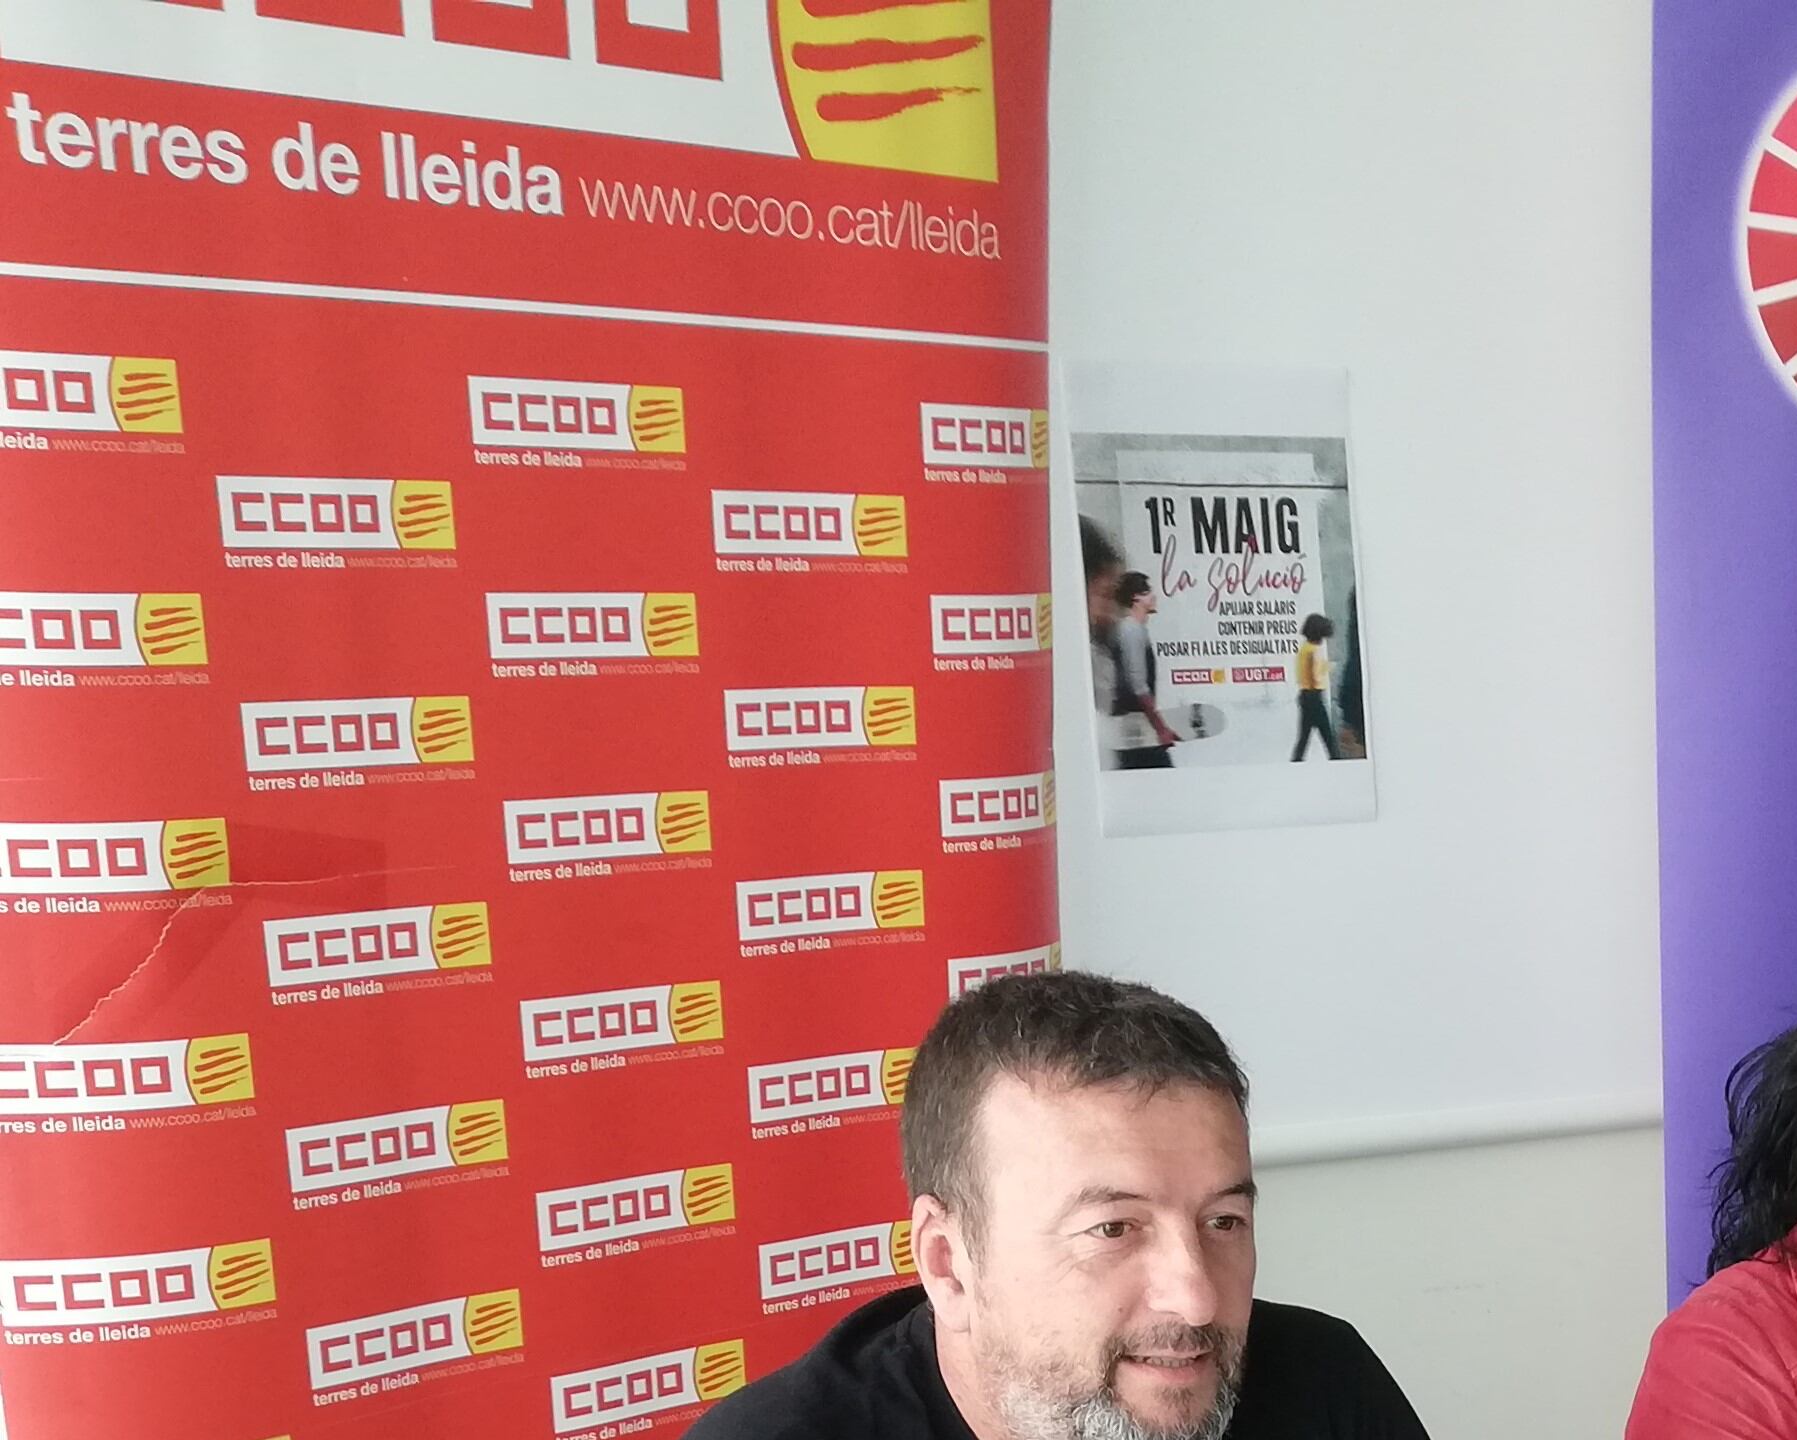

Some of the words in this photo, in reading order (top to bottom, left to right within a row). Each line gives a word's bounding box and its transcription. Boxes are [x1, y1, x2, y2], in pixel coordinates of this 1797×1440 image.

[5, 91, 249, 185] terres
[271, 121, 361, 196] de
[380, 131, 565, 217] lleida
[578, 176, 1001, 260] www.ccoo.cat/lleida
[483, 393, 617, 435] CCOO
[932, 418, 1024, 454] CCOO
[474, 449, 518, 466] terres
[521, 450, 541, 466] de
[544, 451, 582, 468] lleida
[232, 493, 381, 533] CCOO
[724, 506, 841, 541] CCOO
[1190, 496, 1301, 554] MAIG
[225, 553, 274, 568] terres
[277, 553, 298, 568] de
[301, 552, 345, 568] lleida
[1162, 534, 1197, 597] la
[499, 608, 629, 644] CCOO
[942, 608, 1032, 641] CCOO
[1219, 601, 1254, 616] APUJAR
[1257, 600, 1296, 615] SALARIS
[0, 608, 121, 651] COO
[1218, 621, 1265, 636] CONTENIR
[1267, 620, 1298, 635] PREUS
[1156, 641, 1190, 657] POSAR
[1191, 641, 1199, 656] FI
[1202, 641, 1210, 656] A
[1210, 640, 1228, 656] LES
[1230, 639, 1299, 655] DESIGUALTATS
[256, 714, 400, 756] CCOO
[736, 701, 853, 737] CCOO
[728, 755, 766, 768] terres
[769, 752, 784, 765] de
[787, 750, 820, 764] lleida
[249, 775, 295, 791] terres
[300, 774, 319, 789] de
[323, 770, 365, 786] lleida
[951, 790, 1037, 824] CCOO
[517, 809, 645, 849] CCOO
[0, 839, 147, 879] COO
[509, 868, 552, 882] terres
[556, 863, 572, 877] de
[575, 861, 612, 876] lleida
[748, 887, 861, 927] CCOO
[279, 923, 417, 971] CCOO
[740, 944, 777, 957] terres
[780, 940, 795, 953] de
[798, 936, 831, 951] lleida
[272, 990, 317, 1005] terres
[321, 984, 340, 999] de
[343, 980, 384, 997] lleida
[533, 1001, 657, 1047] CCOO
[526, 1064, 568, 1078] terres
[571, 1059, 588, 1073] de
[591, 1054, 626, 1070] lleida
[759, 1065, 871, 1110] CCOO
[299, 1123, 436, 1176] CCOO
[293, 1193, 338, 1210] terres
[342, 1187, 360, 1202] de
[363, 1180, 402, 1198] lleida
[548, 1185, 671, 1237] CCOO
[771, 1237, 881, 1286] CCOO
[15, 1265, 194, 1311] CCOO
[5, 1329, 63, 1345] terres
[69, 1327, 94, 1343] de
[98, 1324, 151, 1341] lleida
[320, 1315, 452, 1373] CCOO
[313, 1388, 357, 1406] terres
[360, 1382, 378, 1395] de
[381, 1372, 419, 1391] lleida
[563, 1364, 684, 1418] CCOO
